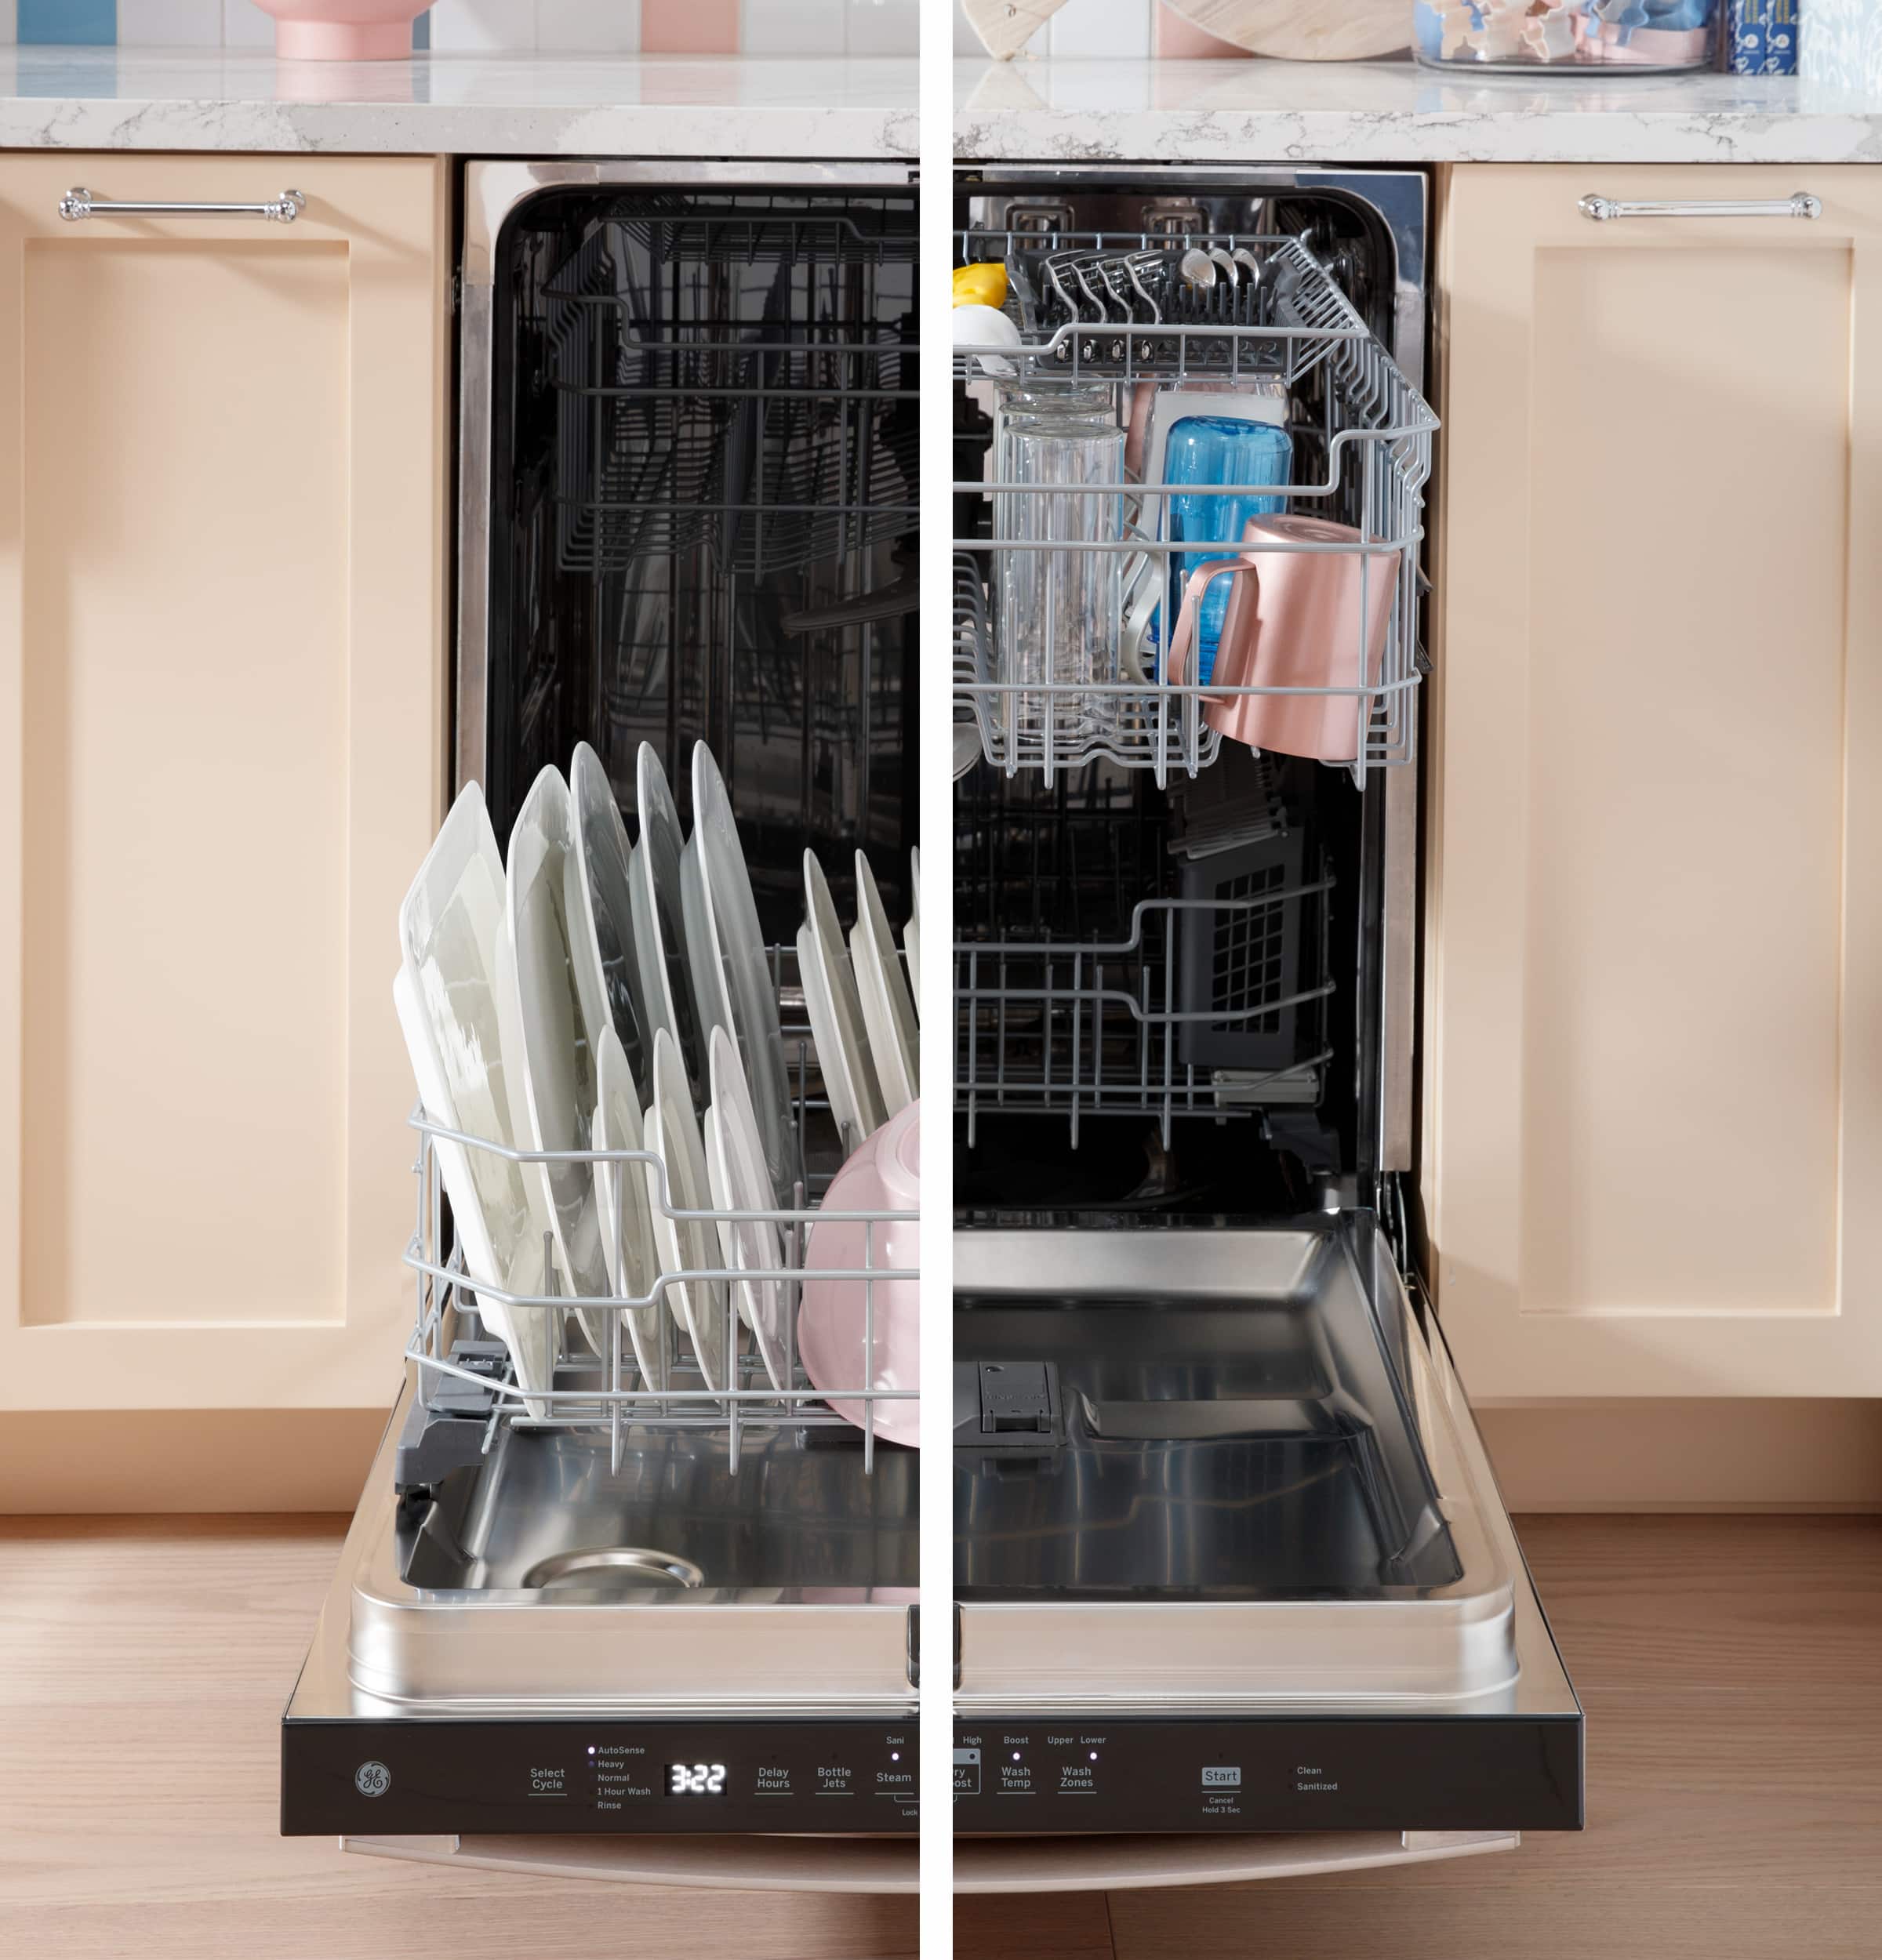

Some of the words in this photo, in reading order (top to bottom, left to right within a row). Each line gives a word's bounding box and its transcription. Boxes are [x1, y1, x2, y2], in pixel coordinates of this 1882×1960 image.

[886, 1736, 904, 1744] Sani
[963, 1736, 983, 1746] High
[1004, 1736, 1029, 1744] Boost
[1048, 1737, 1074, 1746] Upper
[1081, 1736, 1106, 1744] Lower
[598, 1746, 645, 1755] AutoSense
[598, 1760, 625, 1770] Heavy
[530, 1768, 565, 1778] Select
[758, 1767, 789, 1778] Delay
[817, 1767, 852, 1777] Bottle
[953, 1769, 965, 1779] ry
[1001, 1766, 1031, 1777] Wash
[1062, 1766, 1092, 1776] Wash
[1297, 1766, 1322, 1775] Clean
[598, 1773, 630, 1783] Normal
[671, 1764, 727, 1793] 3:22
[876, 1772, 912, 1783] Steam
[1205, 1770, 1237, 1782] Start
[532, 1779, 563, 1791] Cycle
[758, 1778, 790, 1788] Hours
[823, 1778, 846, 1788] Jets
[1001, 1777, 1031, 1789] Temp
[1060, 1777, 1093, 1788] Zones
[1297, 1781, 1338, 1791] Sanitized
[604, 1787, 626, 1795] Hour
[627, 1787, 651, 1795] Wash
[598, 1801, 622, 1809] Rinse
